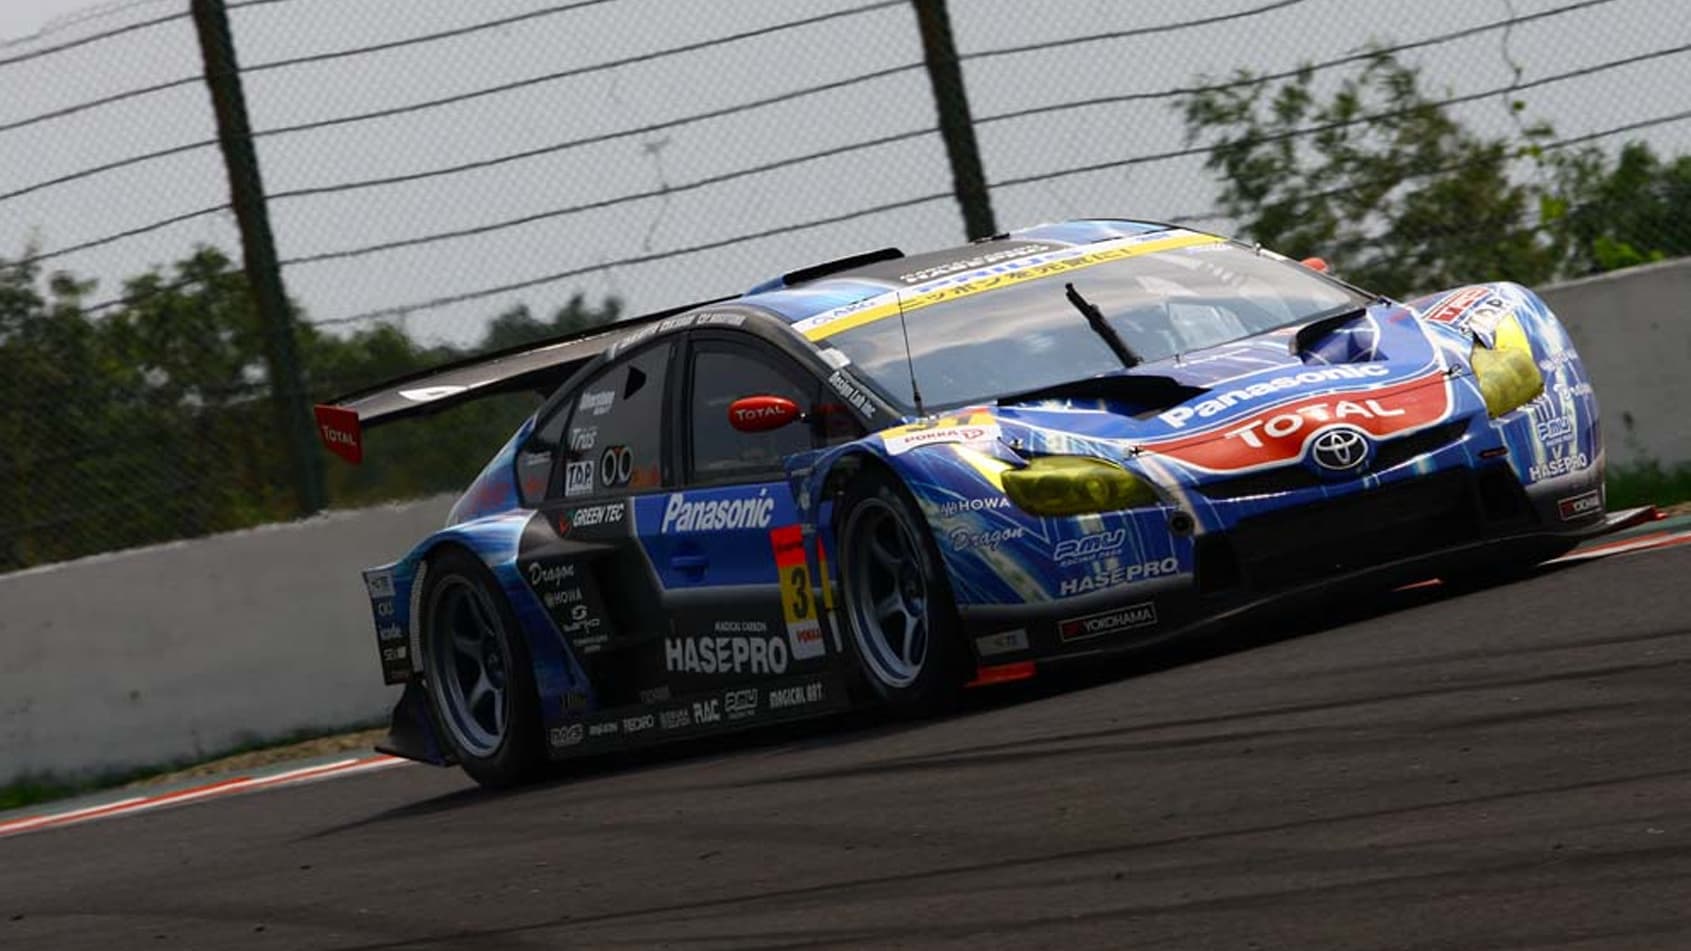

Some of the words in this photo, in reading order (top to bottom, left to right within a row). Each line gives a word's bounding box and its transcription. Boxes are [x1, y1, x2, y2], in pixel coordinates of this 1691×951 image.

[1156, 364, 1389, 430] Panasonic
[736, 405, 787, 422] TOTAL
[1224, 399, 1406, 448] TOTAL
[321, 424, 357, 447] TOTAL
[1529, 453, 1588, 481] HASEPRO
[573, 504, 607, 527] GREEN
[605, 502, 625, 523] TEC
[661, 487, 774, 534] Panasonic
[959, 497, 1011, 511] HOWA
[951, 527, 1024, 552] Dragon
[528, 561, 575, 587] Dragon
[1060, 557, 1179, 596] HASEPRO
[791, 567, 809, 618] 3
[1083, 606, 1153, 632] YOKOHAMA
[665, 635, 788, 674] HASEPRO
